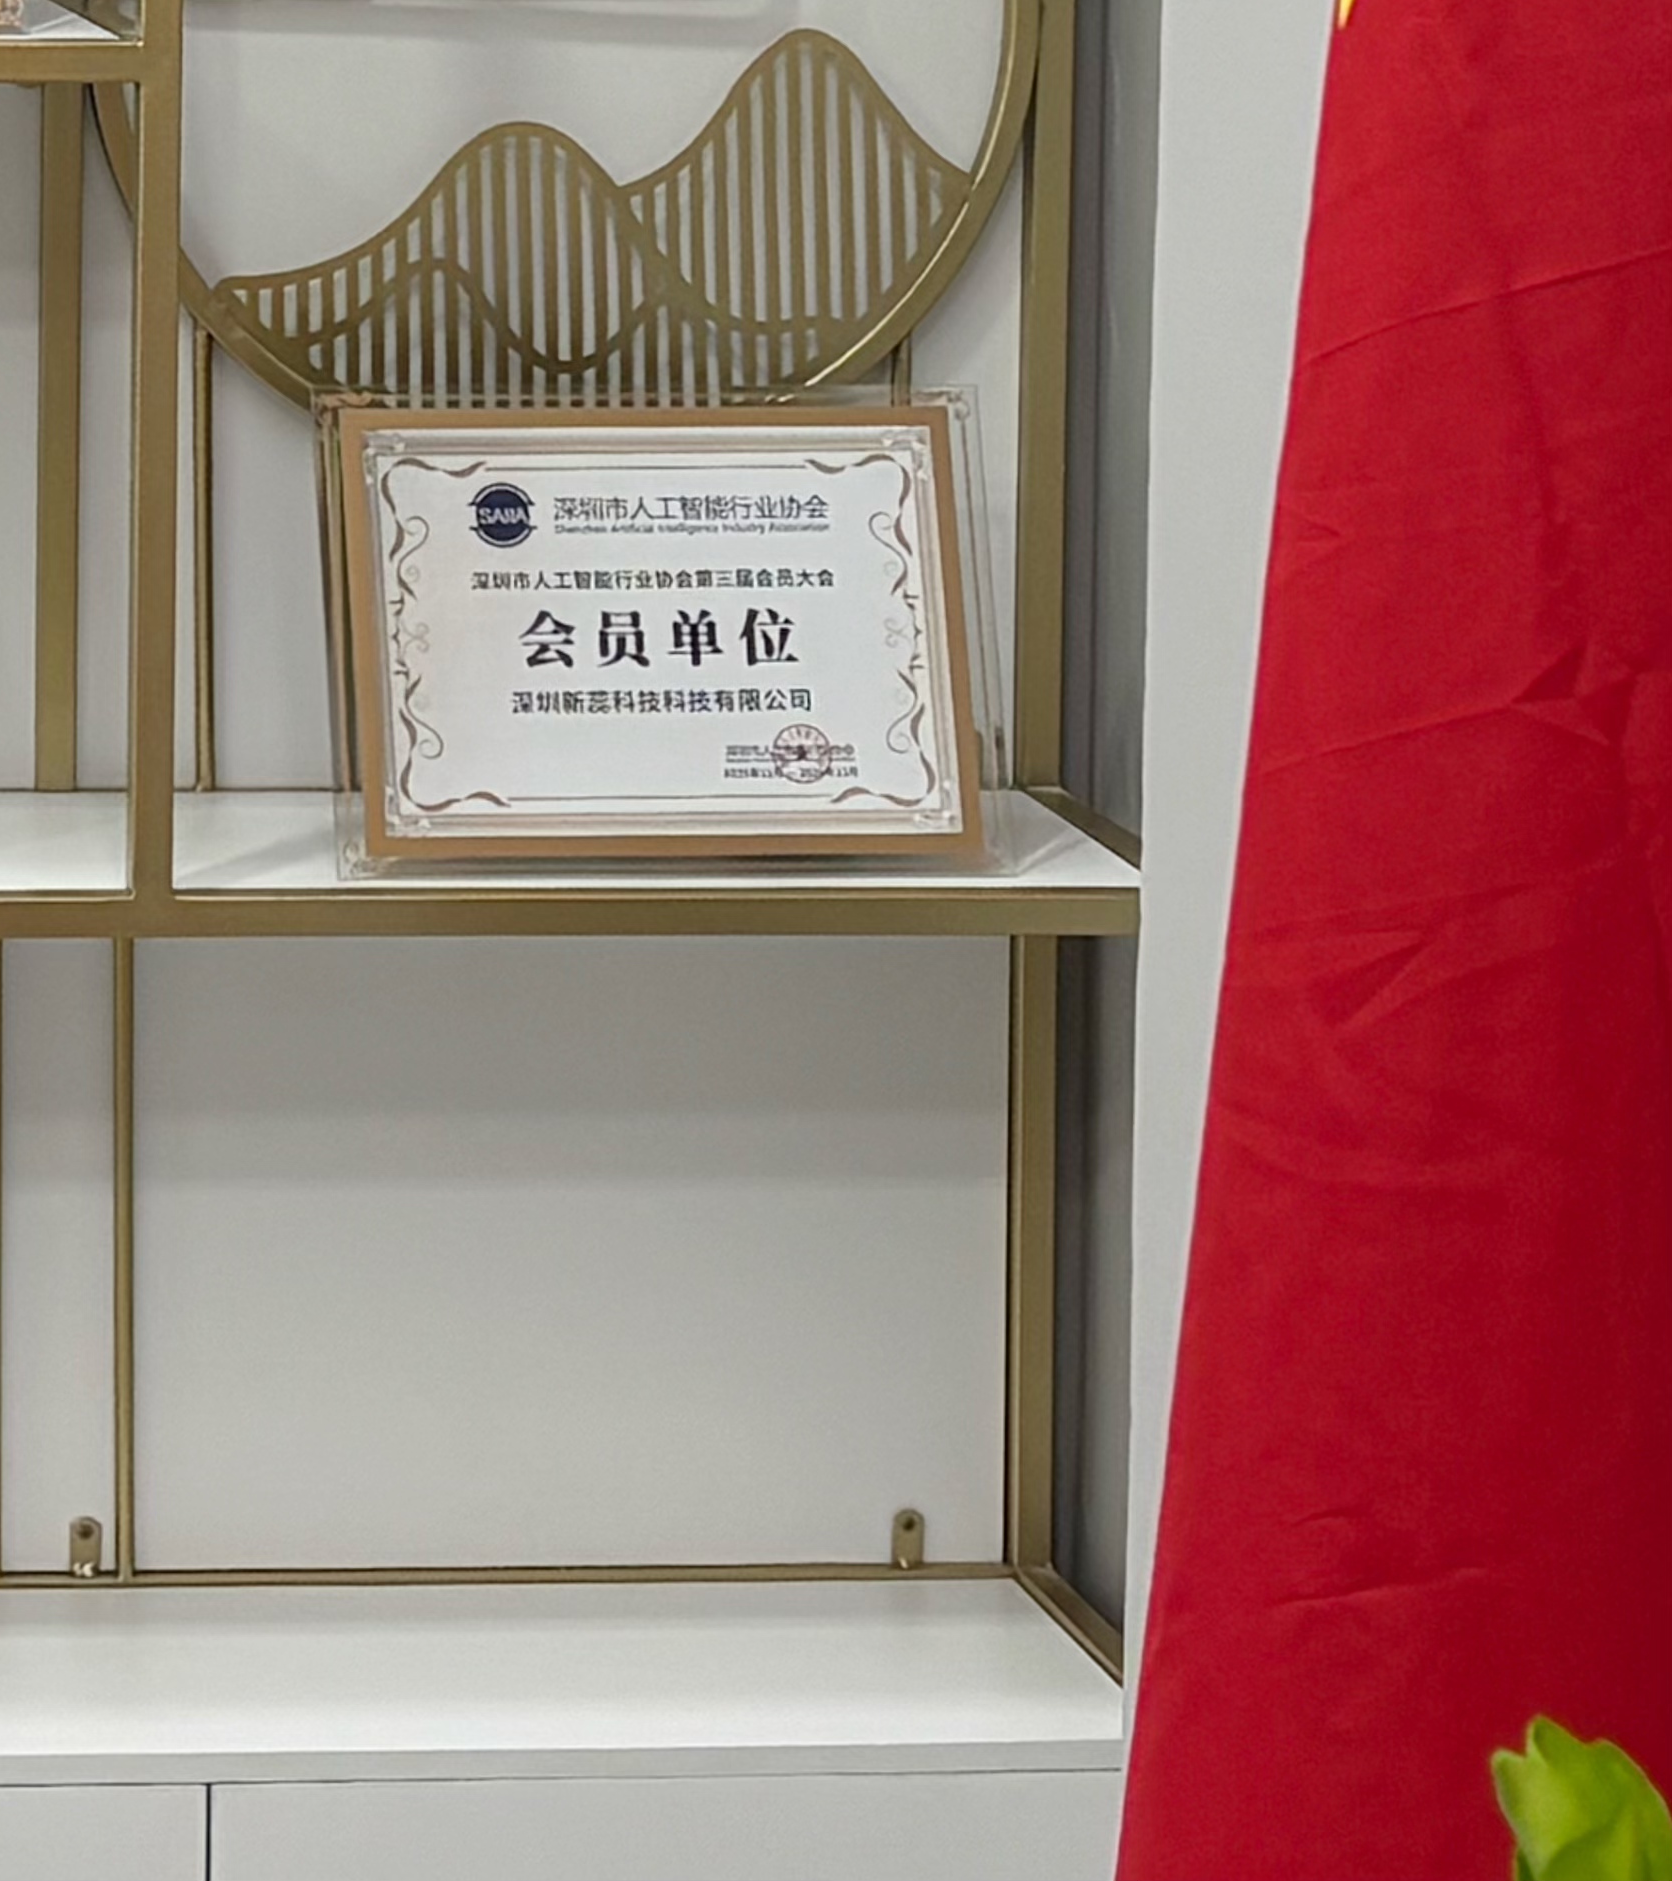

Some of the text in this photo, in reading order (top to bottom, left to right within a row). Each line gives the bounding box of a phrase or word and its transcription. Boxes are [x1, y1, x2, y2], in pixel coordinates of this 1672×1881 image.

[554, 495, 830, 521] 深圳市人工智能行业协会
[518, 607, 802, 669] 会员单位
